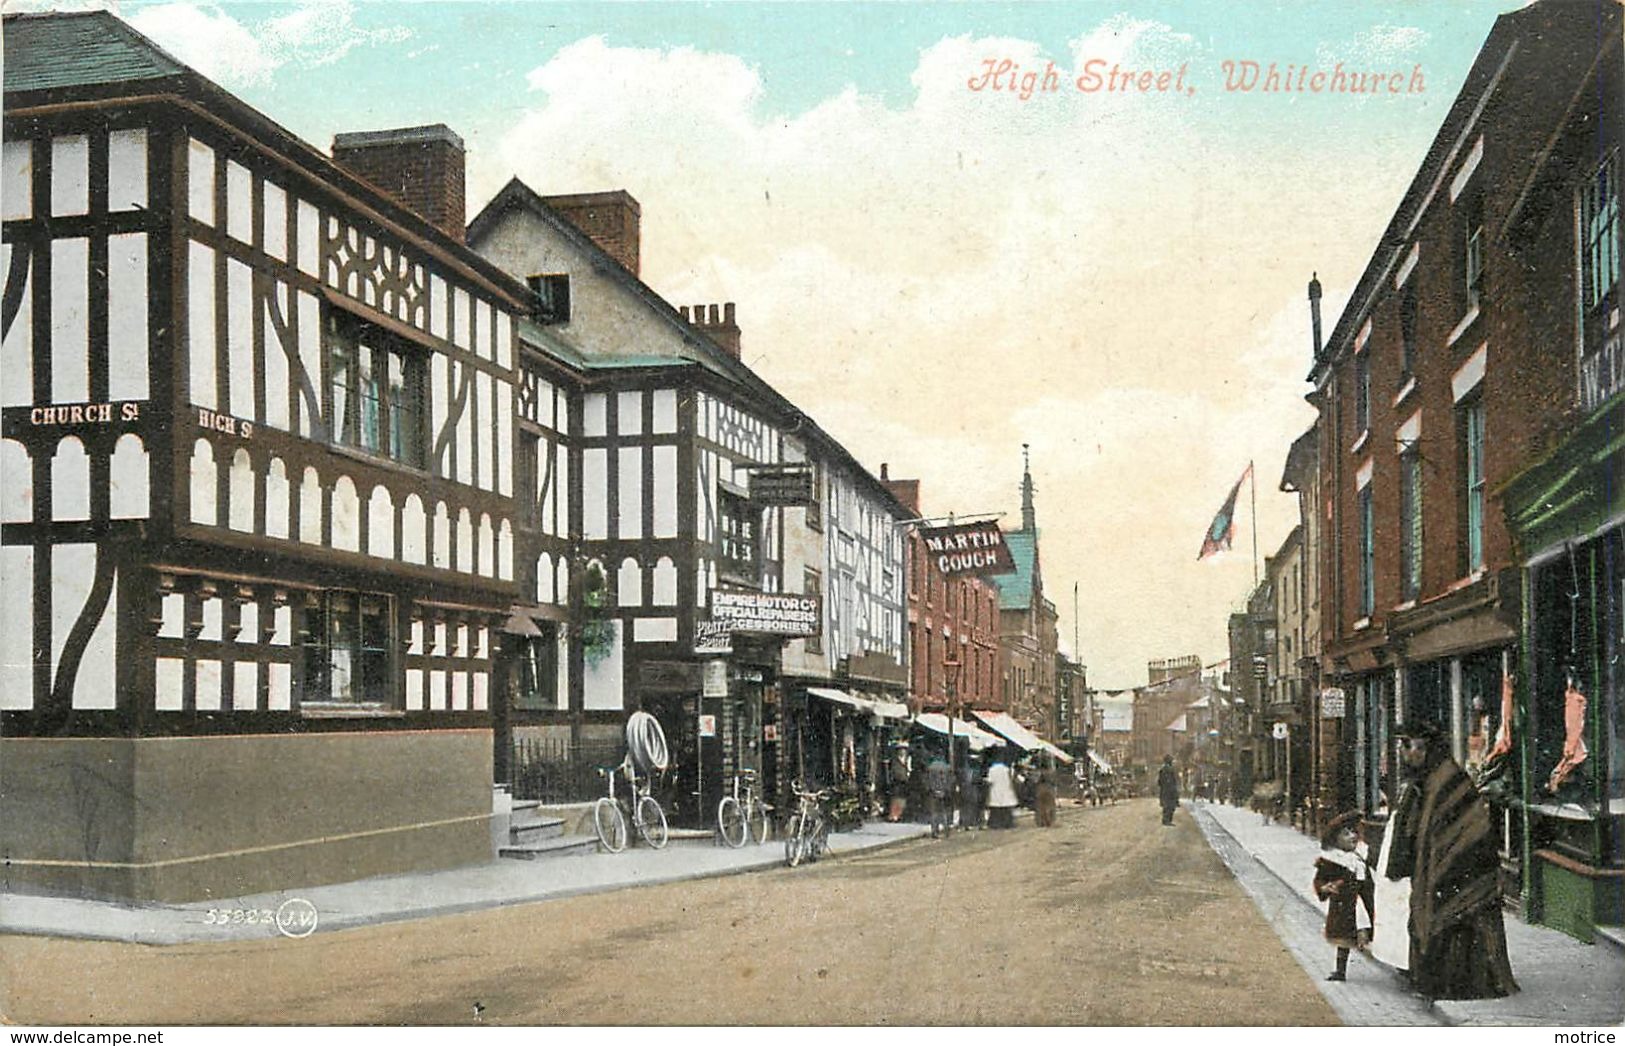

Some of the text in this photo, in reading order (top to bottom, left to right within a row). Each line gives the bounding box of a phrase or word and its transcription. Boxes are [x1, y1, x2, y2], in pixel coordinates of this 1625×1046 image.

[31, 403, 112, 425] CHURCH
[925, 530, 1001, 553] MARTIN
[712, 590, 756, 607] EMPIRE
[756, 594, 799, 610] MOTOR
[712, 604, 816, 623] OFFICIAL REPAIRERS
